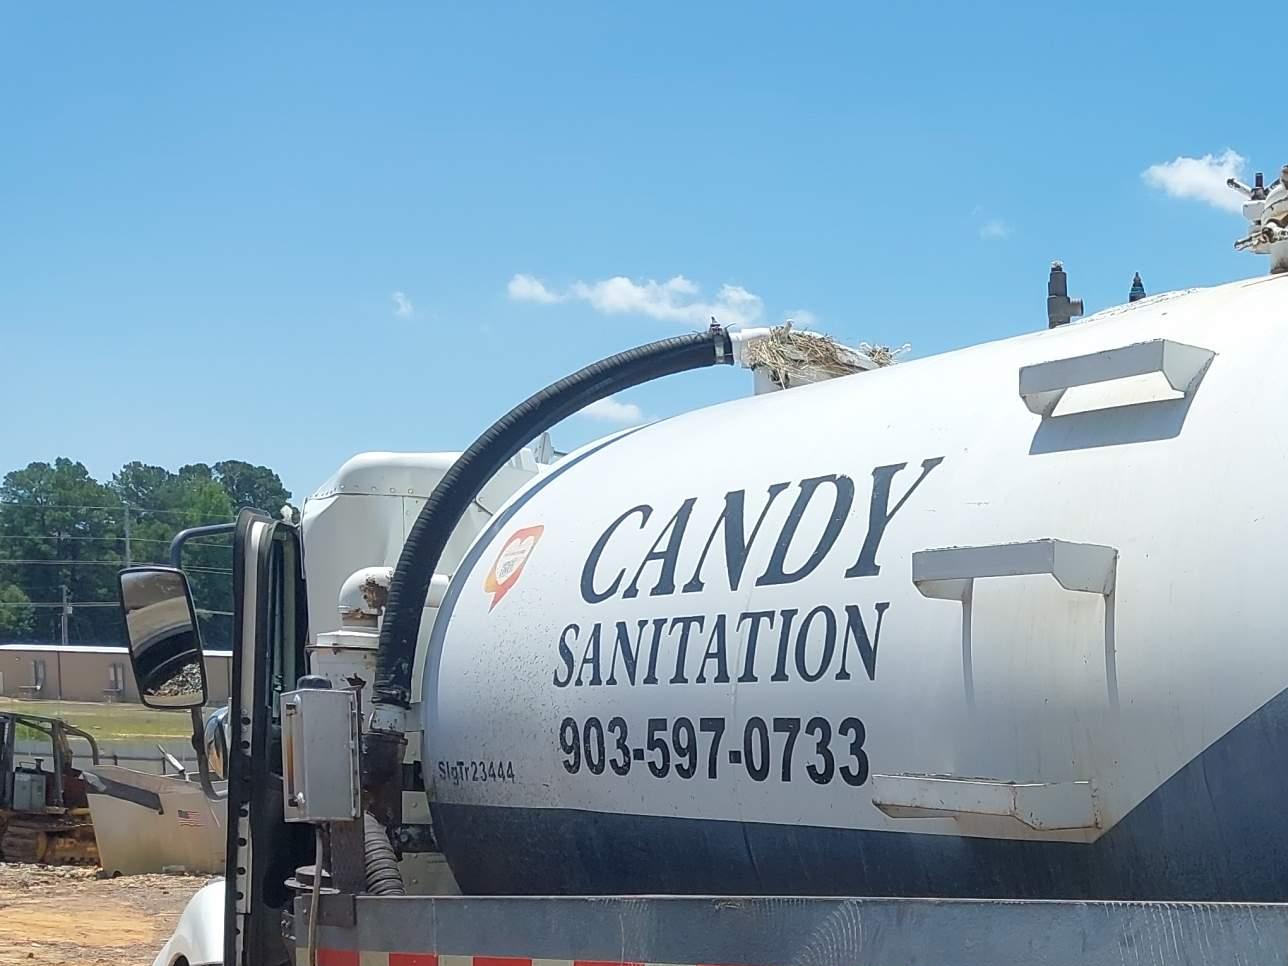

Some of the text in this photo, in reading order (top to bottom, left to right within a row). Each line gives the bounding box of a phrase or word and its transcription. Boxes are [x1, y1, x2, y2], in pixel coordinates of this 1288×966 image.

[580, 456, 945, 604] CANDY
[553, 602, 890, 689] SANITATION
[559, 715, 870, 787] 903-597-0733
